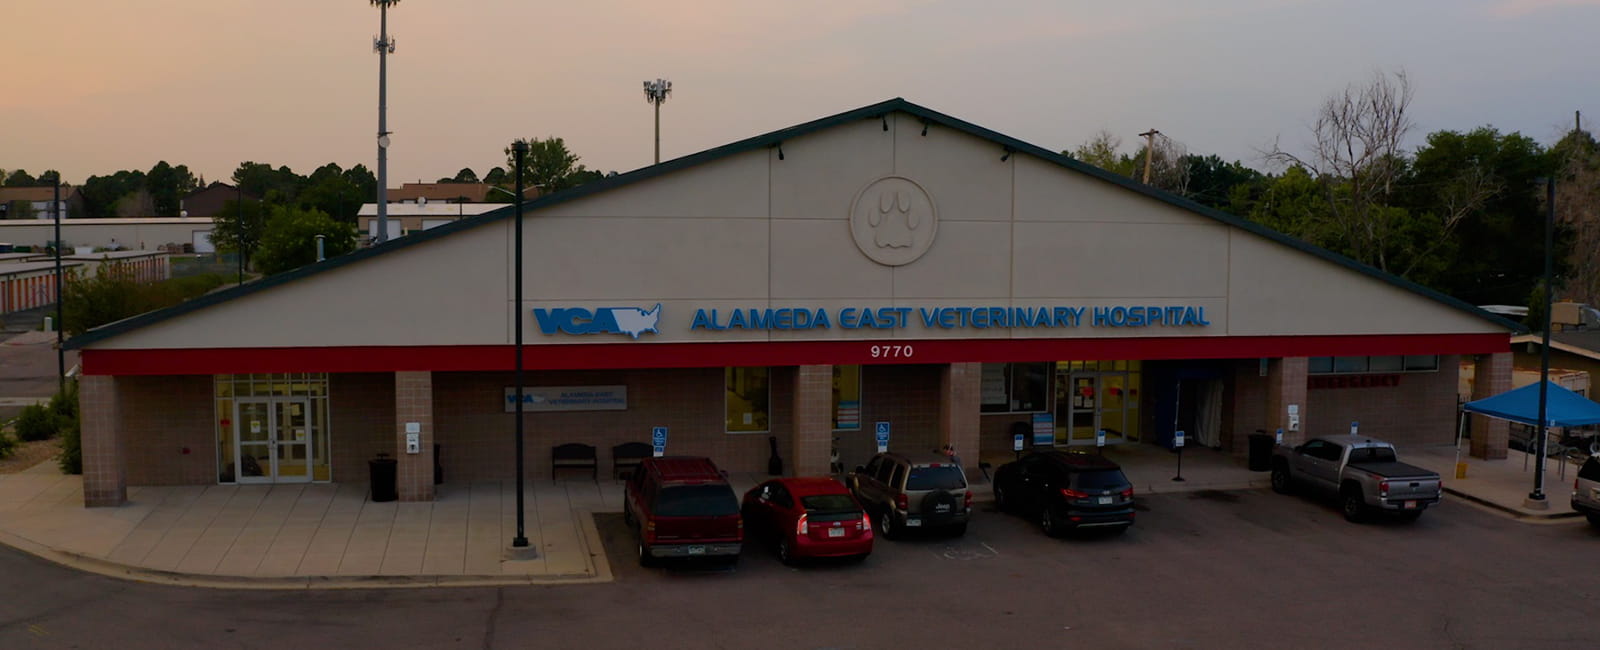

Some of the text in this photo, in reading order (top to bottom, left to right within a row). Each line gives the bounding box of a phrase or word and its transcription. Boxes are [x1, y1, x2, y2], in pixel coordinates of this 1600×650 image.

[533, 307, 621, 335] VCA
[690, 305, 1211, 330] ALAMEDA EAST VETERINARY HOSPITAL
[870, 345, 913, 358] 9770
